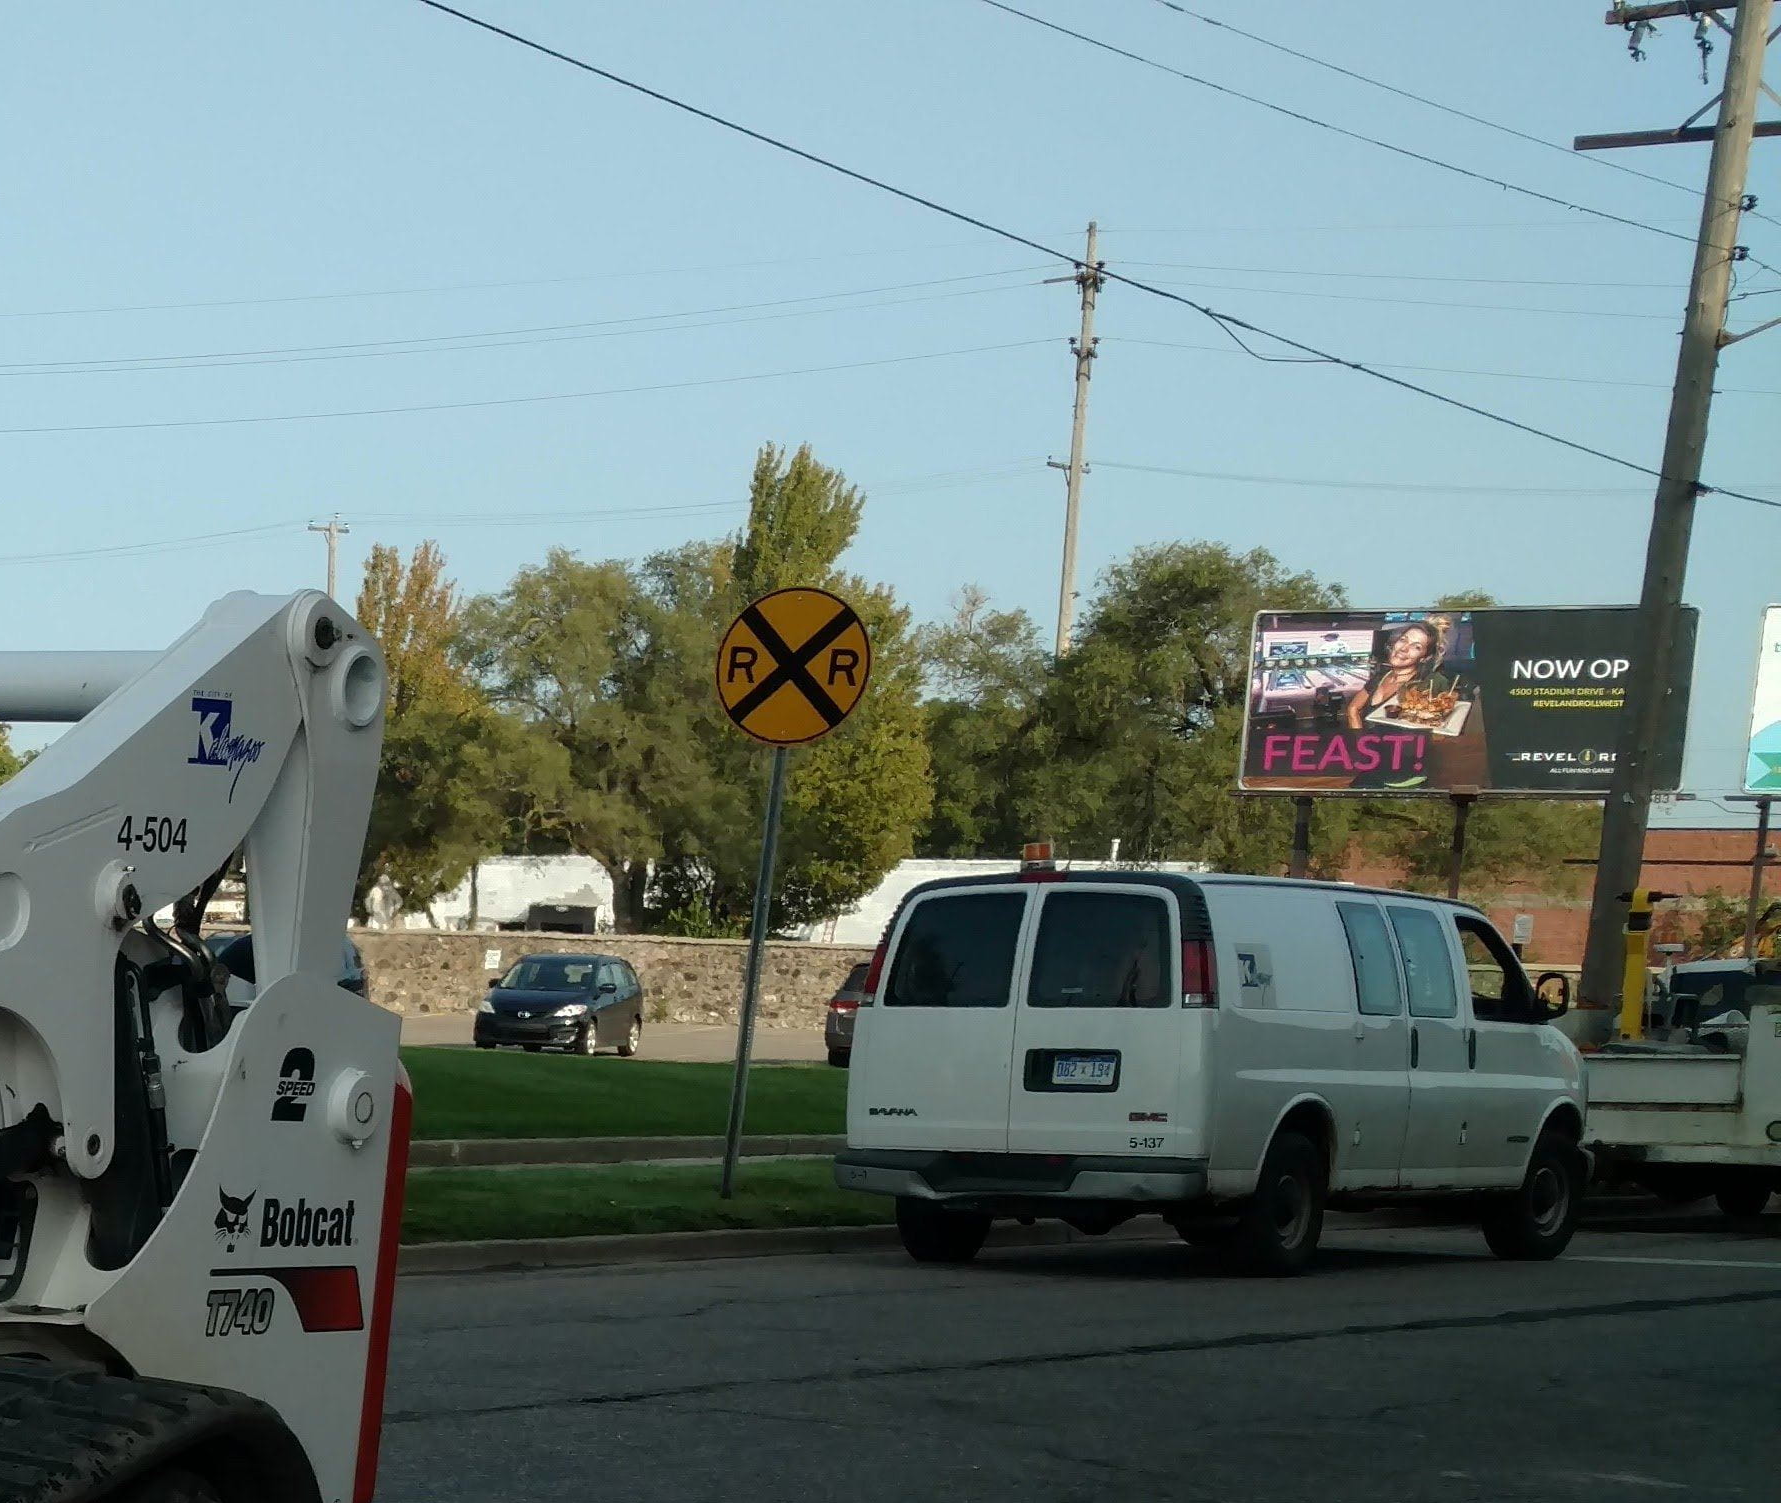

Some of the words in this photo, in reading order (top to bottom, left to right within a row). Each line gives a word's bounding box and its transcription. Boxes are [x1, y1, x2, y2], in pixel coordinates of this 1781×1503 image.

[1513, 660, 1584, 679] NOW
[1590, 659, 1630, 679] OP
[1533, 687, 1575, 696] STADIUM
[1577, 687, 1605, 696] DRIVE
[1611, 687, 1625, 696] KA
[1263, 734, 1427, 772] FEAST!
[117, 815, 187, 853] 4-504
[270, 1047, 315, 1121] 2
[276, 1080, 316, 1096] SPEED
[1129, 1137, 1165, 1149] 5-137
[260, 1198, 355, 1247] Bobcat
[206, 1288, 274, 1337] T740
